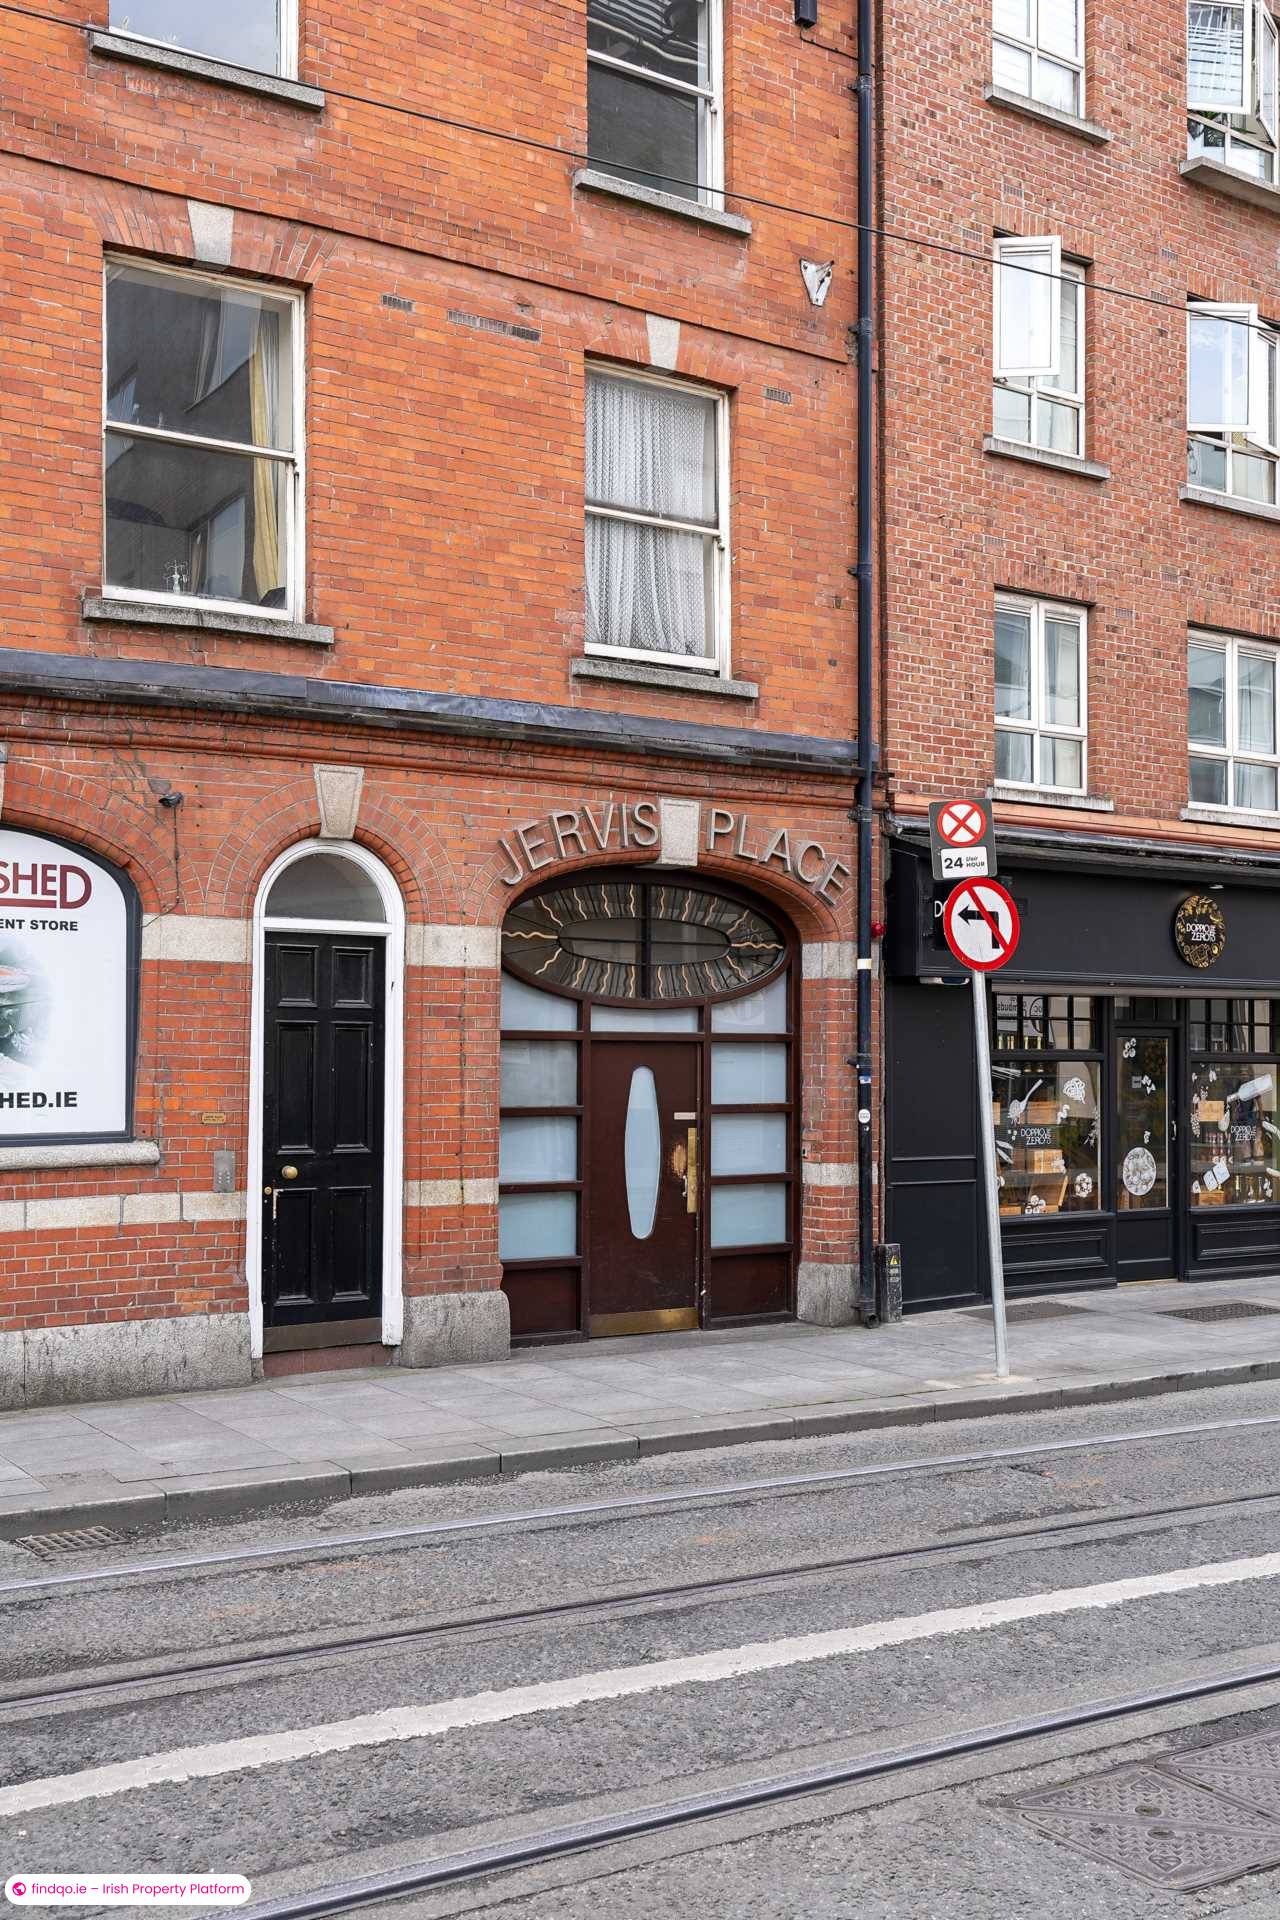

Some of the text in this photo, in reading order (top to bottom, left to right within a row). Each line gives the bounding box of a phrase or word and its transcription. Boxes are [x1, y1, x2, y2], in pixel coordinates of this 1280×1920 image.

[497, 801, 850, 906] JERVIS PLACE
[944, 857, 963, 869] 24
[30, 919, 78, 931] STORE
